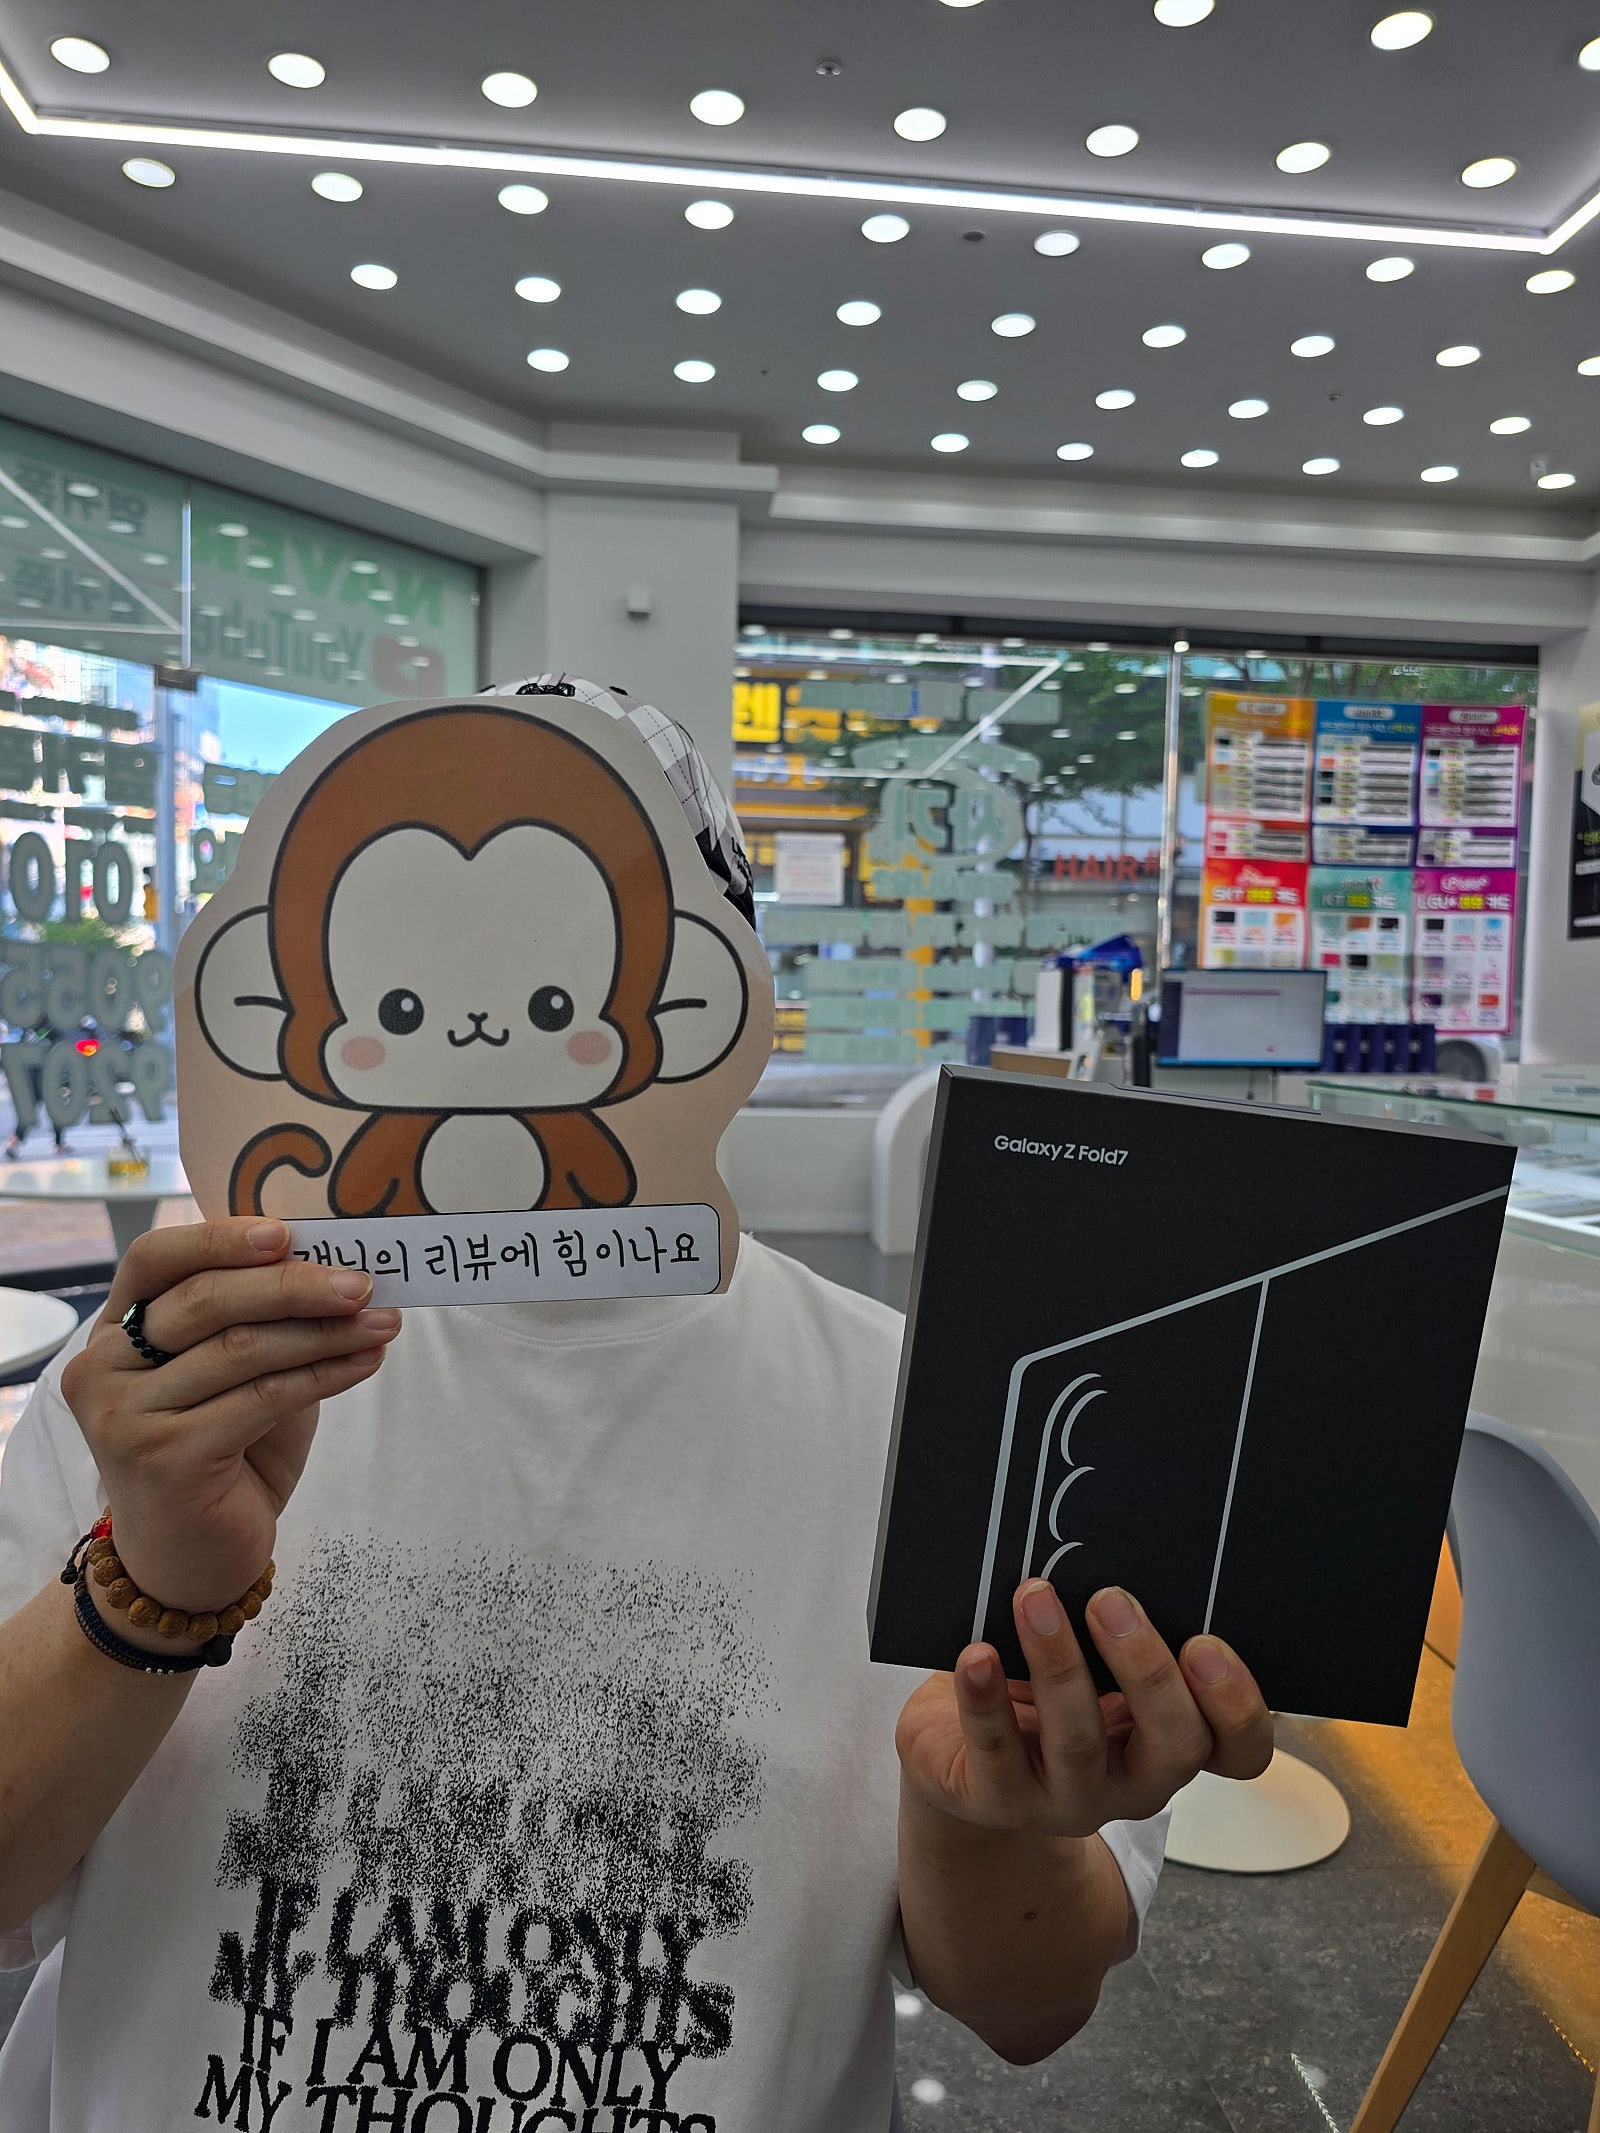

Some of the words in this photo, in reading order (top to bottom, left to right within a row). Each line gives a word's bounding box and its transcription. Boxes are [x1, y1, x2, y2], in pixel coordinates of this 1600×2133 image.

[994, 1135, 1062, 1161] Galaxy
[1063, 1143, 1076, 1159] Z
[1078, 1145, 1129, 1166] Fold7
[425, 1232, 540, 1283] 리뷰에
[240, 2001, 293, 2074] IF
[306, 2017, 337, 2087] I
[346, 2021, 471, 2094] AM
[493, 2033, 692, 2111] ONLY
[194, 2053, 293, 2133] MY
